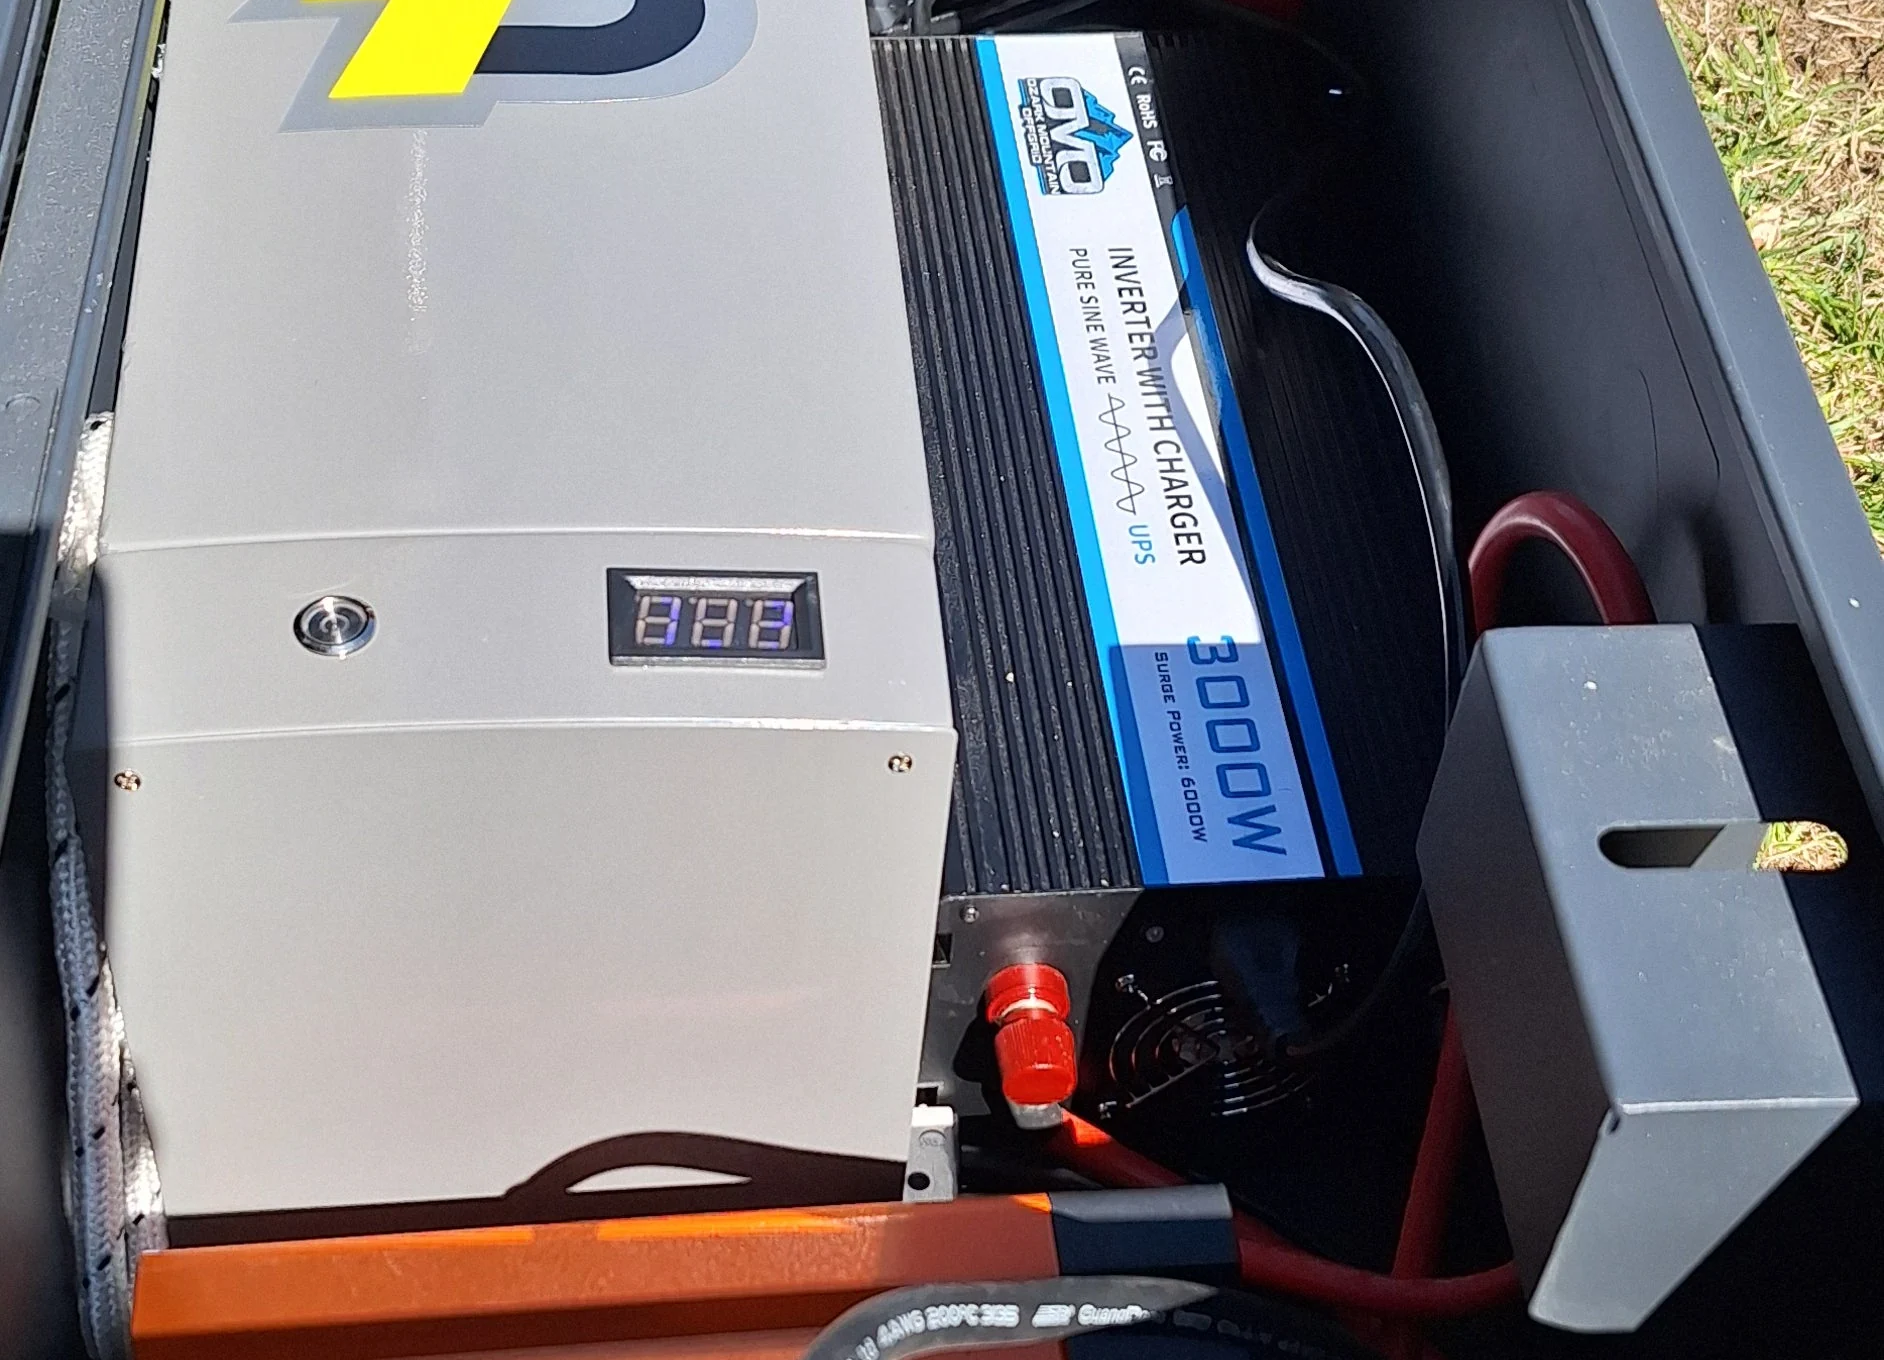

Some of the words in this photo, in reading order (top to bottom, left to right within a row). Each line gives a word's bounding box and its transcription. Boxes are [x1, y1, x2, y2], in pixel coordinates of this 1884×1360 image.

[1027, 78, 1047, 124] OZARK
[1136, 93, 1158, 130] RoHS
[1022, 107, 1043, 165] OFFGRID
[1036, 124, 1062, 196] MOUNTAIN
[1069, 247, 1096, 291] PURE
[1079, 294, 1106, 333] SINE
[1107, 246, 1156, 362] INVERTER
[1088, 337, 1117, 386] WAVE
[1136, 365, 1177, 432] WITH
[1152, 439, 1206, 567] CHARGER
[1128, 524, 1156, 566] UPS
[1154, 651, 1176, 704] SURGE
[1167, 709, 1190, 771] POWER:
[1180, 777, 1208, 844] 6000W
[1186, 634, 1288, 856] 3000W
